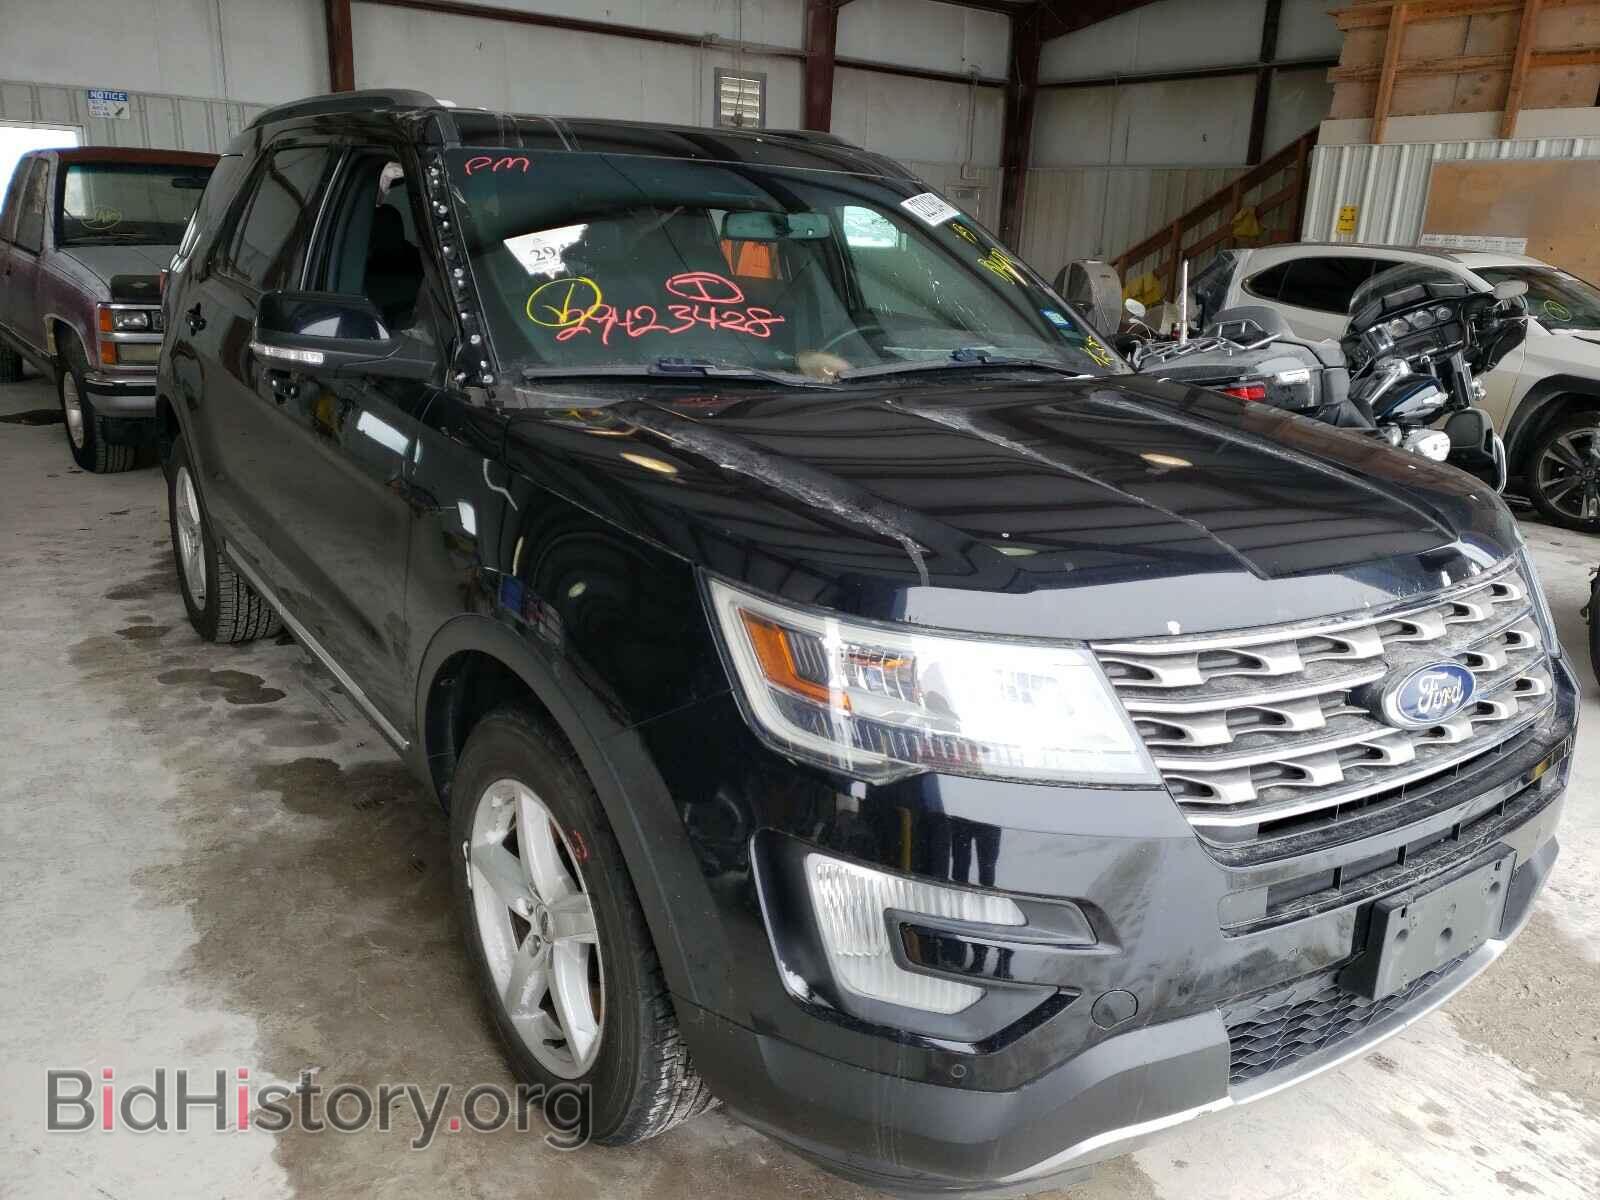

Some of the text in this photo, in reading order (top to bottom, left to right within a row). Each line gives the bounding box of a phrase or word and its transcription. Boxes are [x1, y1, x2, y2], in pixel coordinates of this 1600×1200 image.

[90, 90, 128, 101] NOTICE
[556, 303, 785, 345] 29423428
[1417, 672, 1464, 714] Ford
